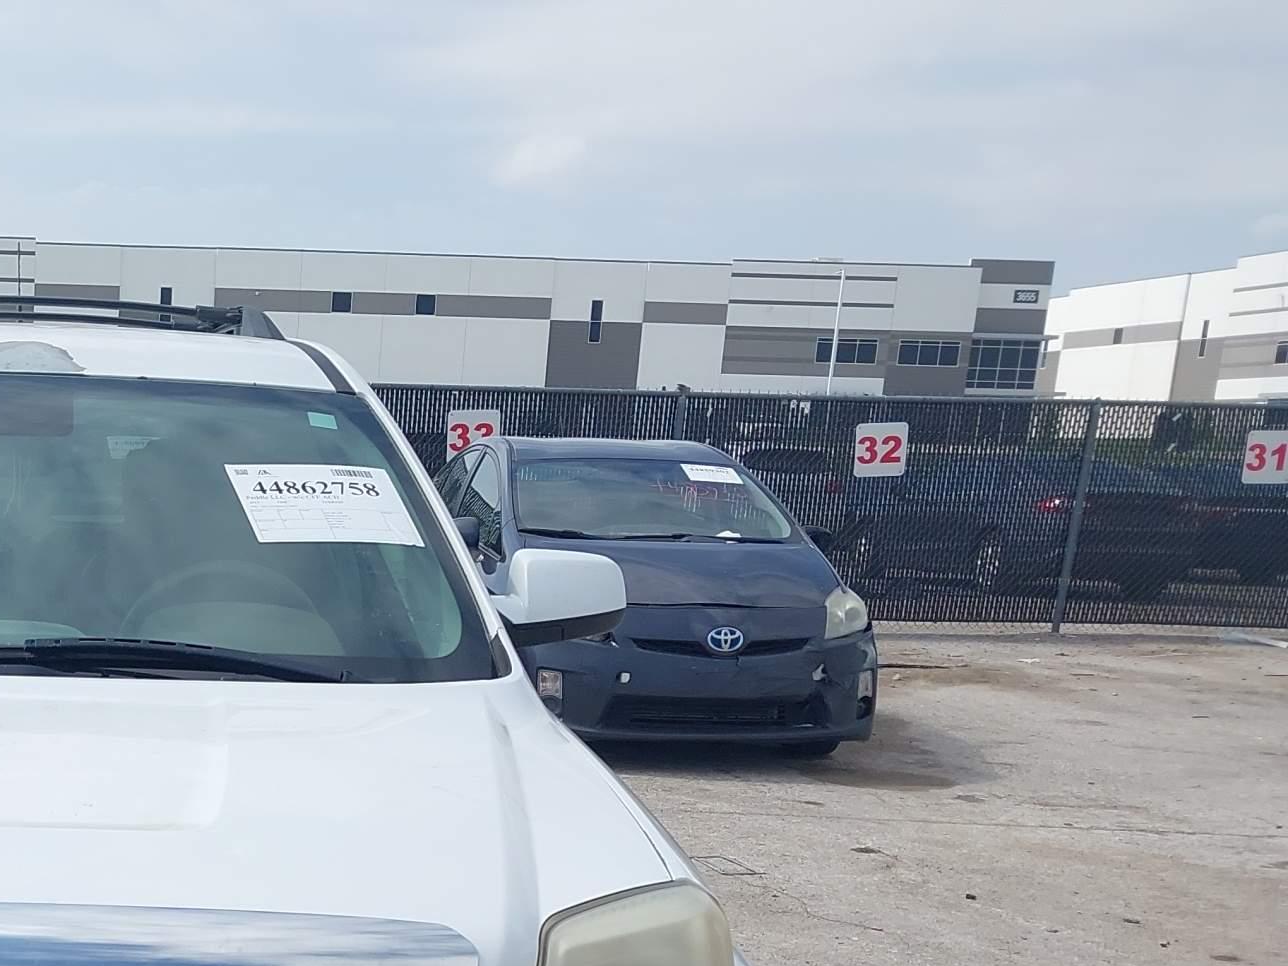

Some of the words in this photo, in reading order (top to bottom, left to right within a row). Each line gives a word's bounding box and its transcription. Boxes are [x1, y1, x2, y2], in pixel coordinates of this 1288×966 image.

[856, 435, 902, 465] 32
[1246, 443, 1288, 471] 31
[252, 480, 380, 497] 44862758
